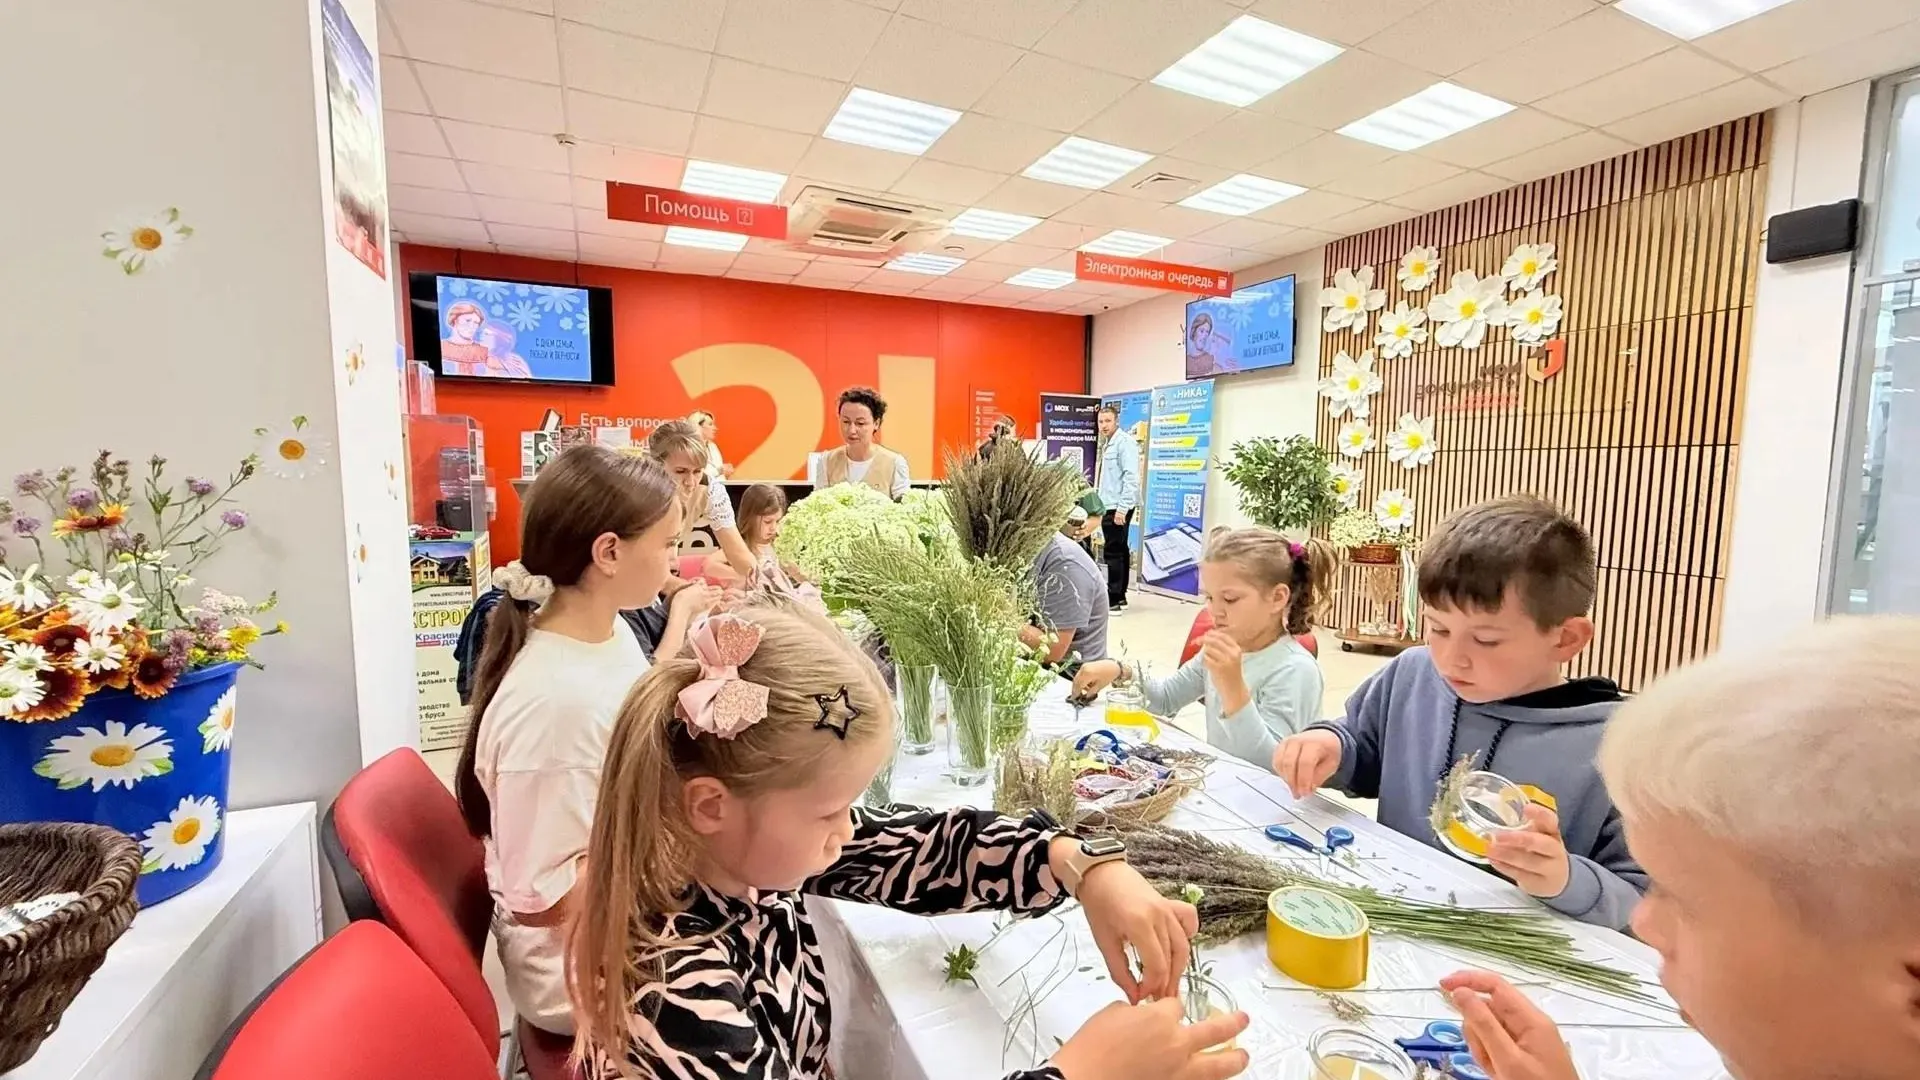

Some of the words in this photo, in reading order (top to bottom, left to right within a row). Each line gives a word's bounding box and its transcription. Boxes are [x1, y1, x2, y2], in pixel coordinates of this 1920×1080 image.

[645, 193, 730, 224] Помощь
[1083, 257, 1165, 281] Электронная
[1167, 271, 1214, 289] очередь
[580, 413, 613, 428] Есть
